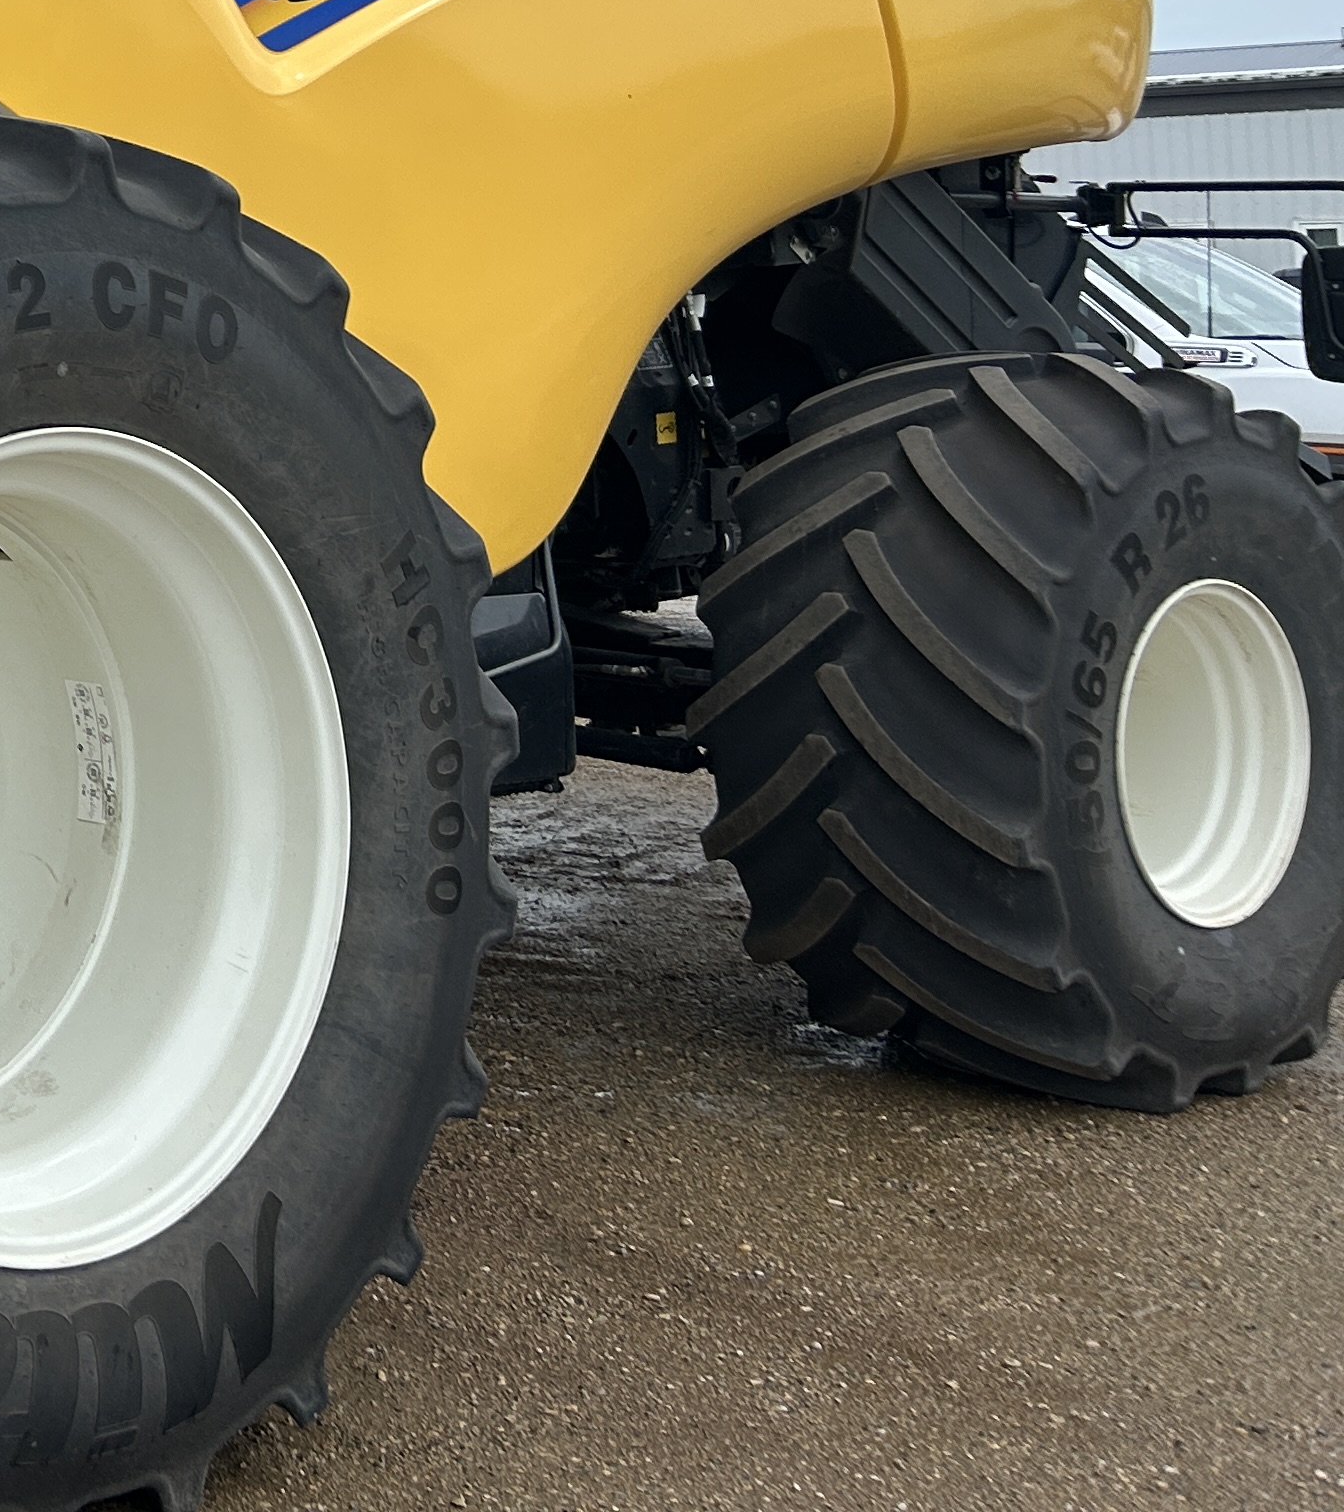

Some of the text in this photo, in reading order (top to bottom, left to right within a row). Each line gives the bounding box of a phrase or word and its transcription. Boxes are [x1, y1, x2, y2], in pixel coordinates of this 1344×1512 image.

[91, 260, 239, 365] CFO
[1109, 532, 1153, 595] R
[1154, 473, 1210, 552] 26
